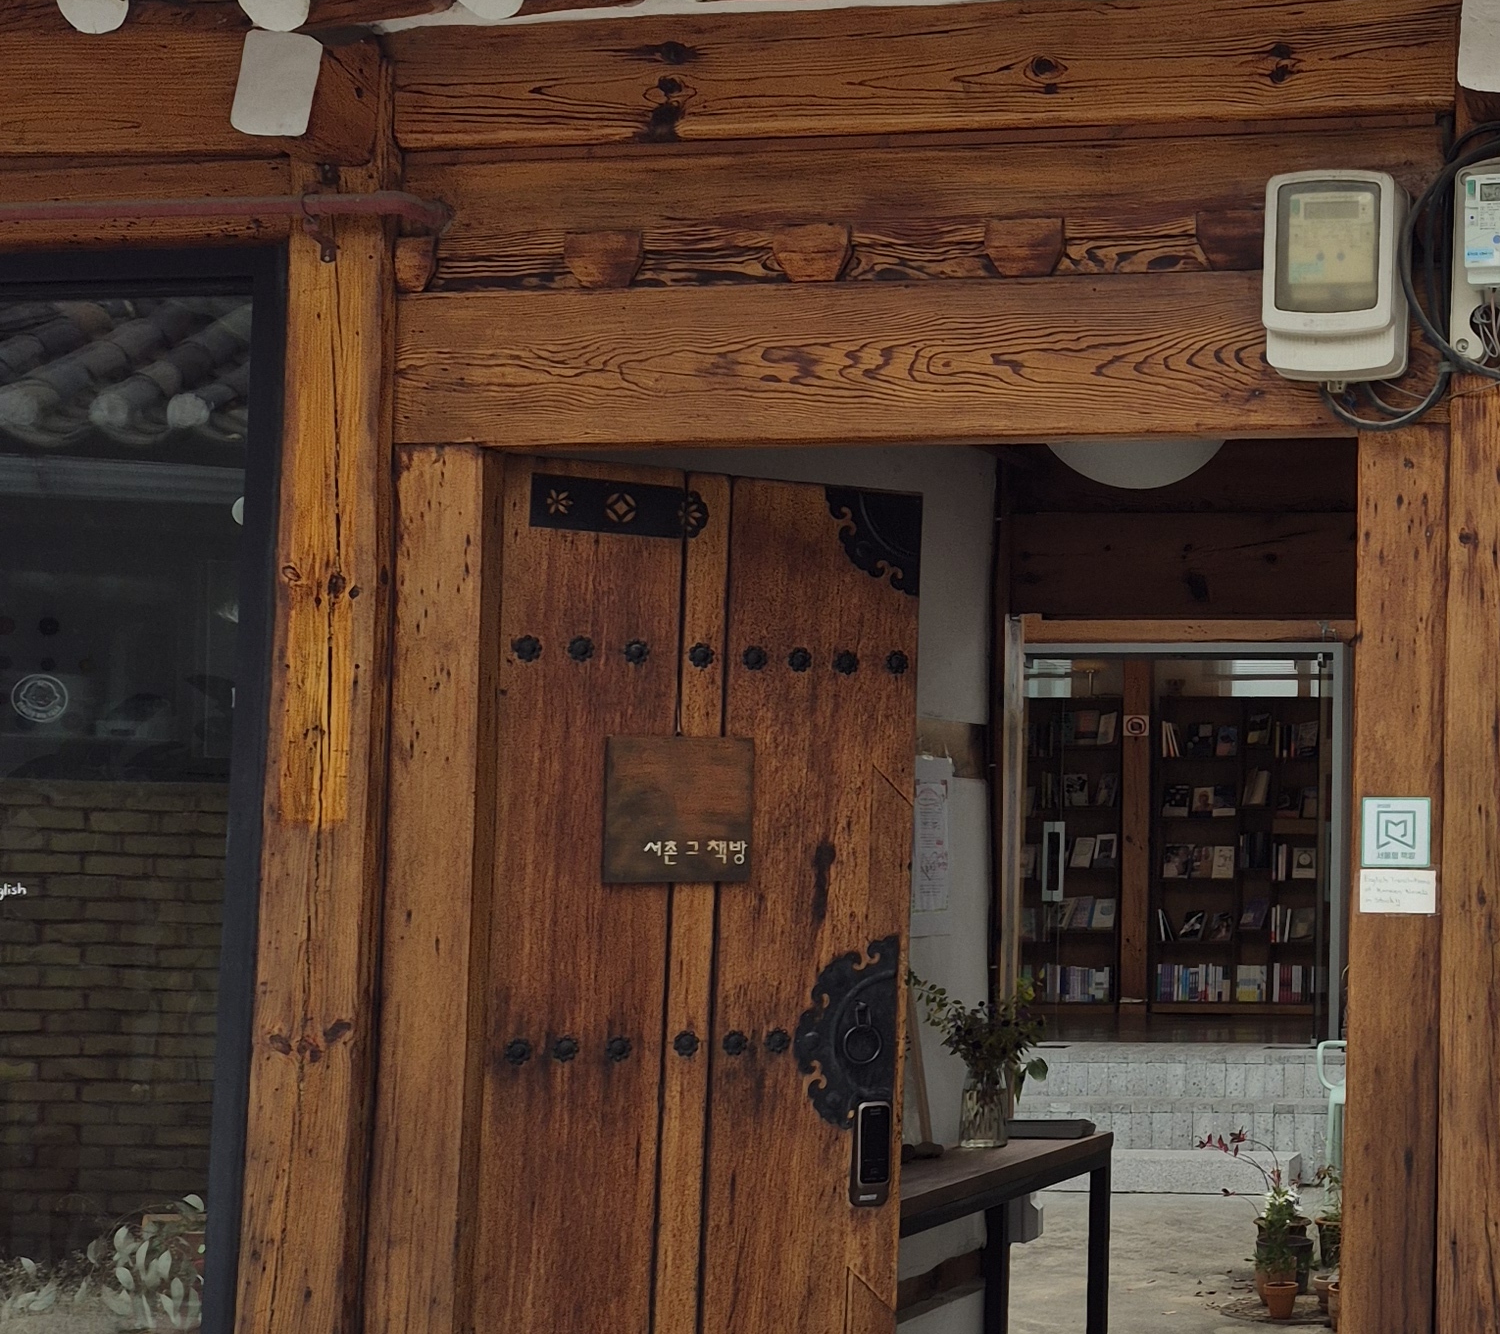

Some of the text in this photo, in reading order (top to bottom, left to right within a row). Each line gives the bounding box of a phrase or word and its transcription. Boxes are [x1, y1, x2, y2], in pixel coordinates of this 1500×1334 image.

[642, 839, 749, 866] 서촌 그 책방
